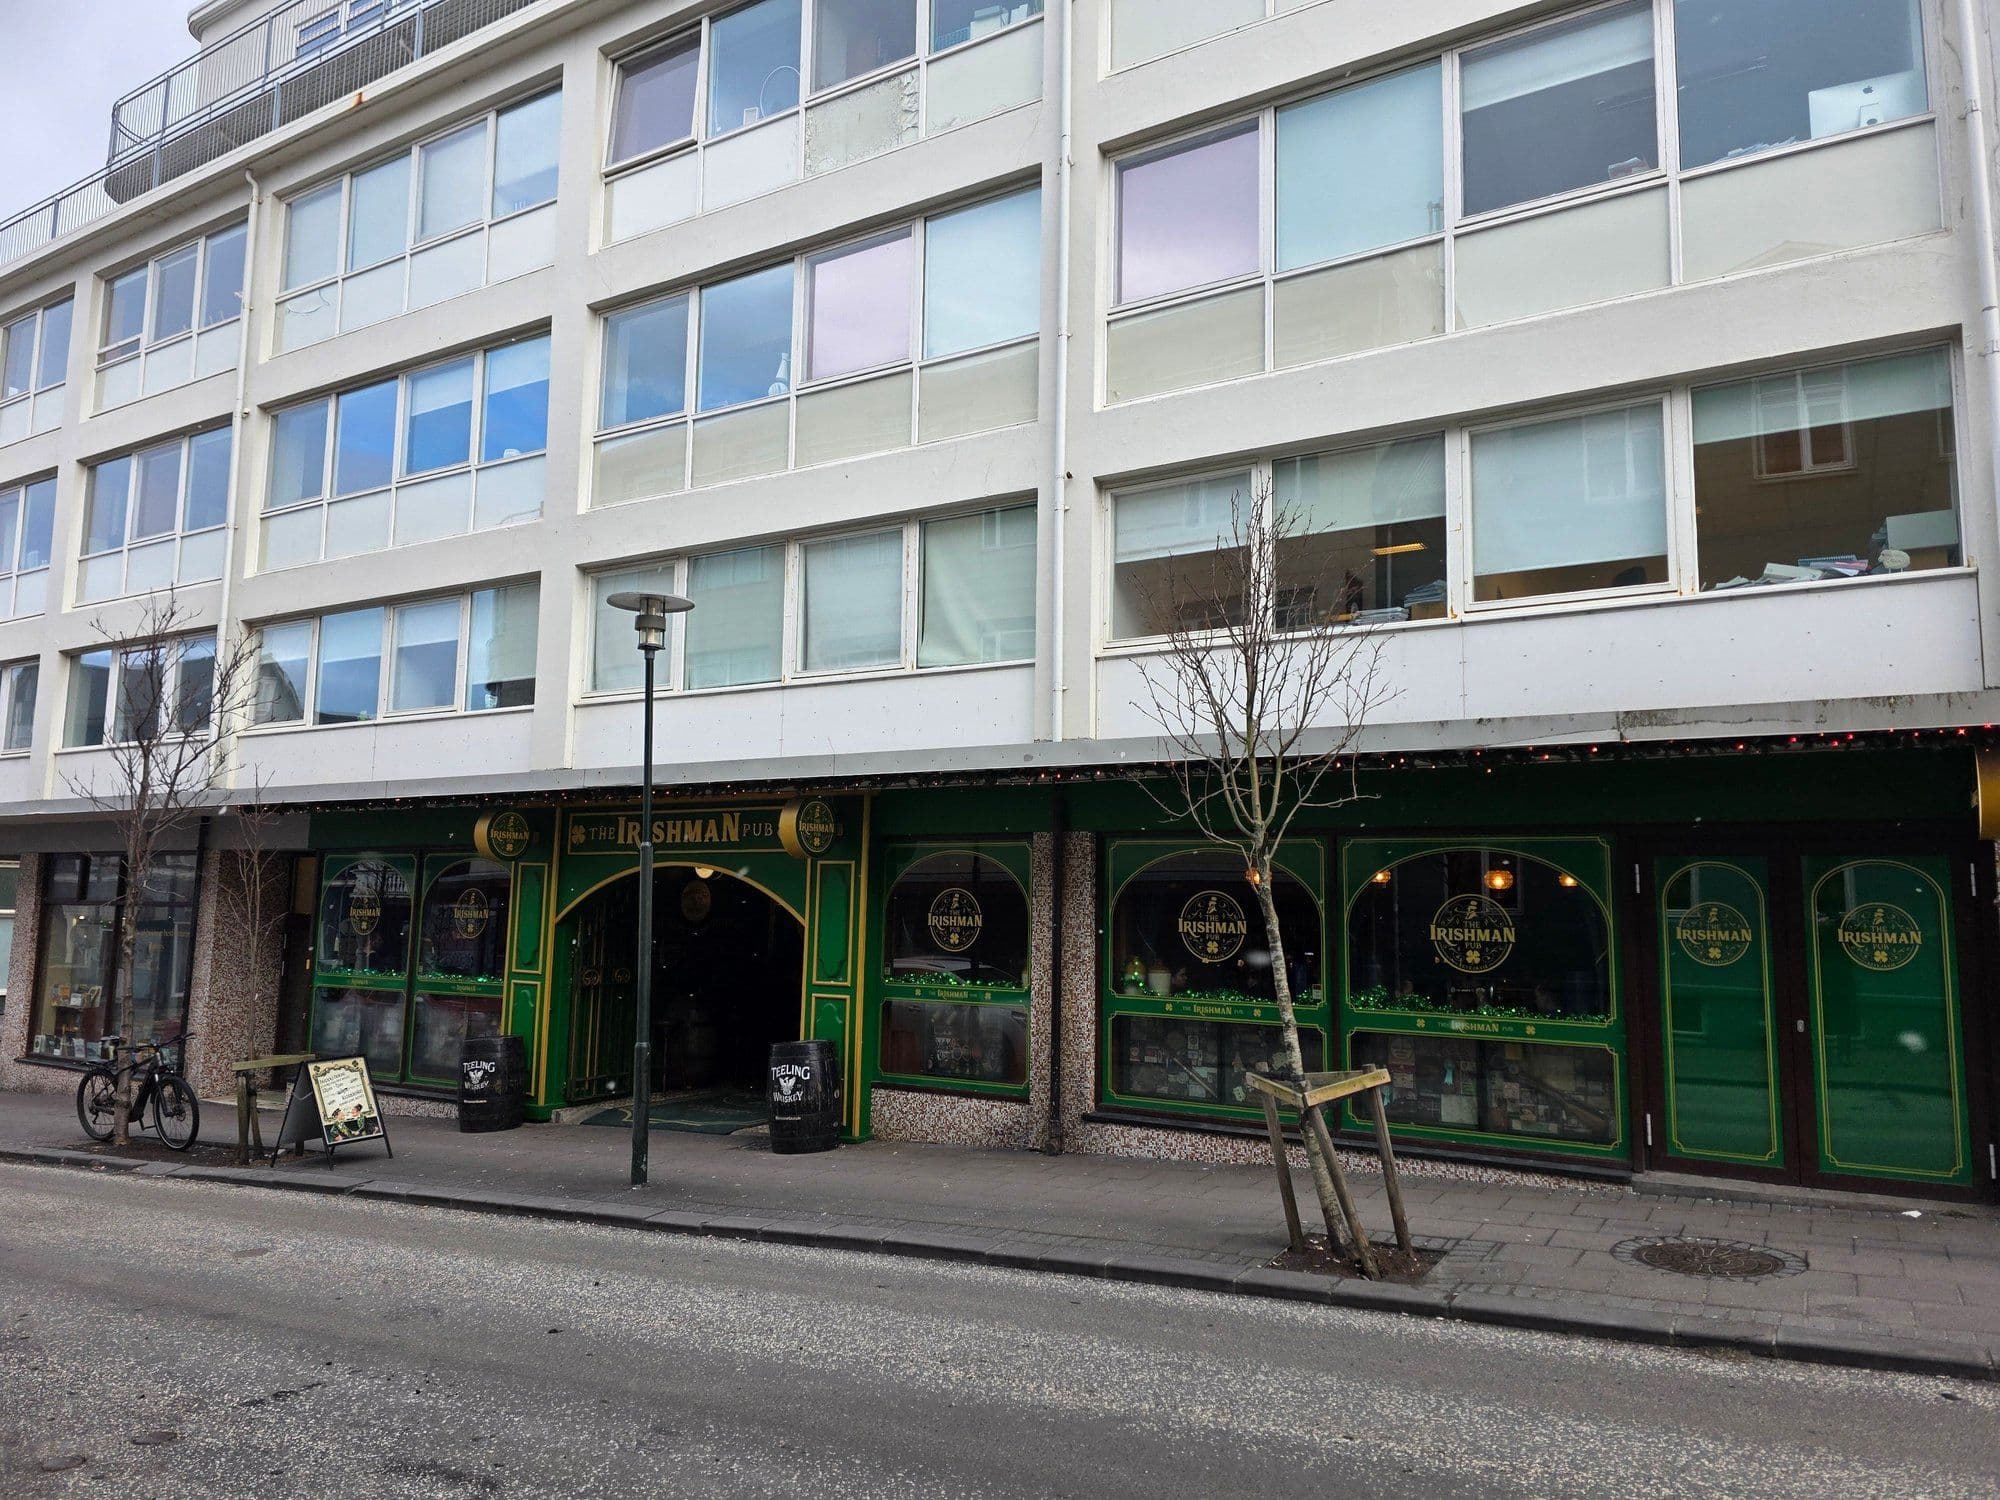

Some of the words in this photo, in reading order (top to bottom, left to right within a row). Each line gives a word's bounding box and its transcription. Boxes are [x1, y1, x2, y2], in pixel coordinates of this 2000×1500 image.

[490, 828, 529, 841] IRISHMAN
[590, 825, 615, 840] THE
[616, 812, 741, 847] IRSHMAN
[742, 822, 774, 837] PUB
[927, 912, 982, 930] IRISHMAN
[1178, 918, 1247, 937] IRISHMAN
[1463, 921, 1481, 929] THE
[1430, 924, 1516, 946] IRISHMAN
[1676, 926, 1752, 944] IRISHMAN
[1837, 928, 1922, 947] IRISHMAN
[937, 989, 969, 999] IRISHMAN
[1193, 1004, 1232, 1016] IRISHMAN
[1451, 1019, 1499, 1033] IRISHMAN
[463, 1060, 496, 1073] TEELING
[771, 1064, 810, 1080] TEELING
[773, 1091, 803, 1103] WHISKEY
